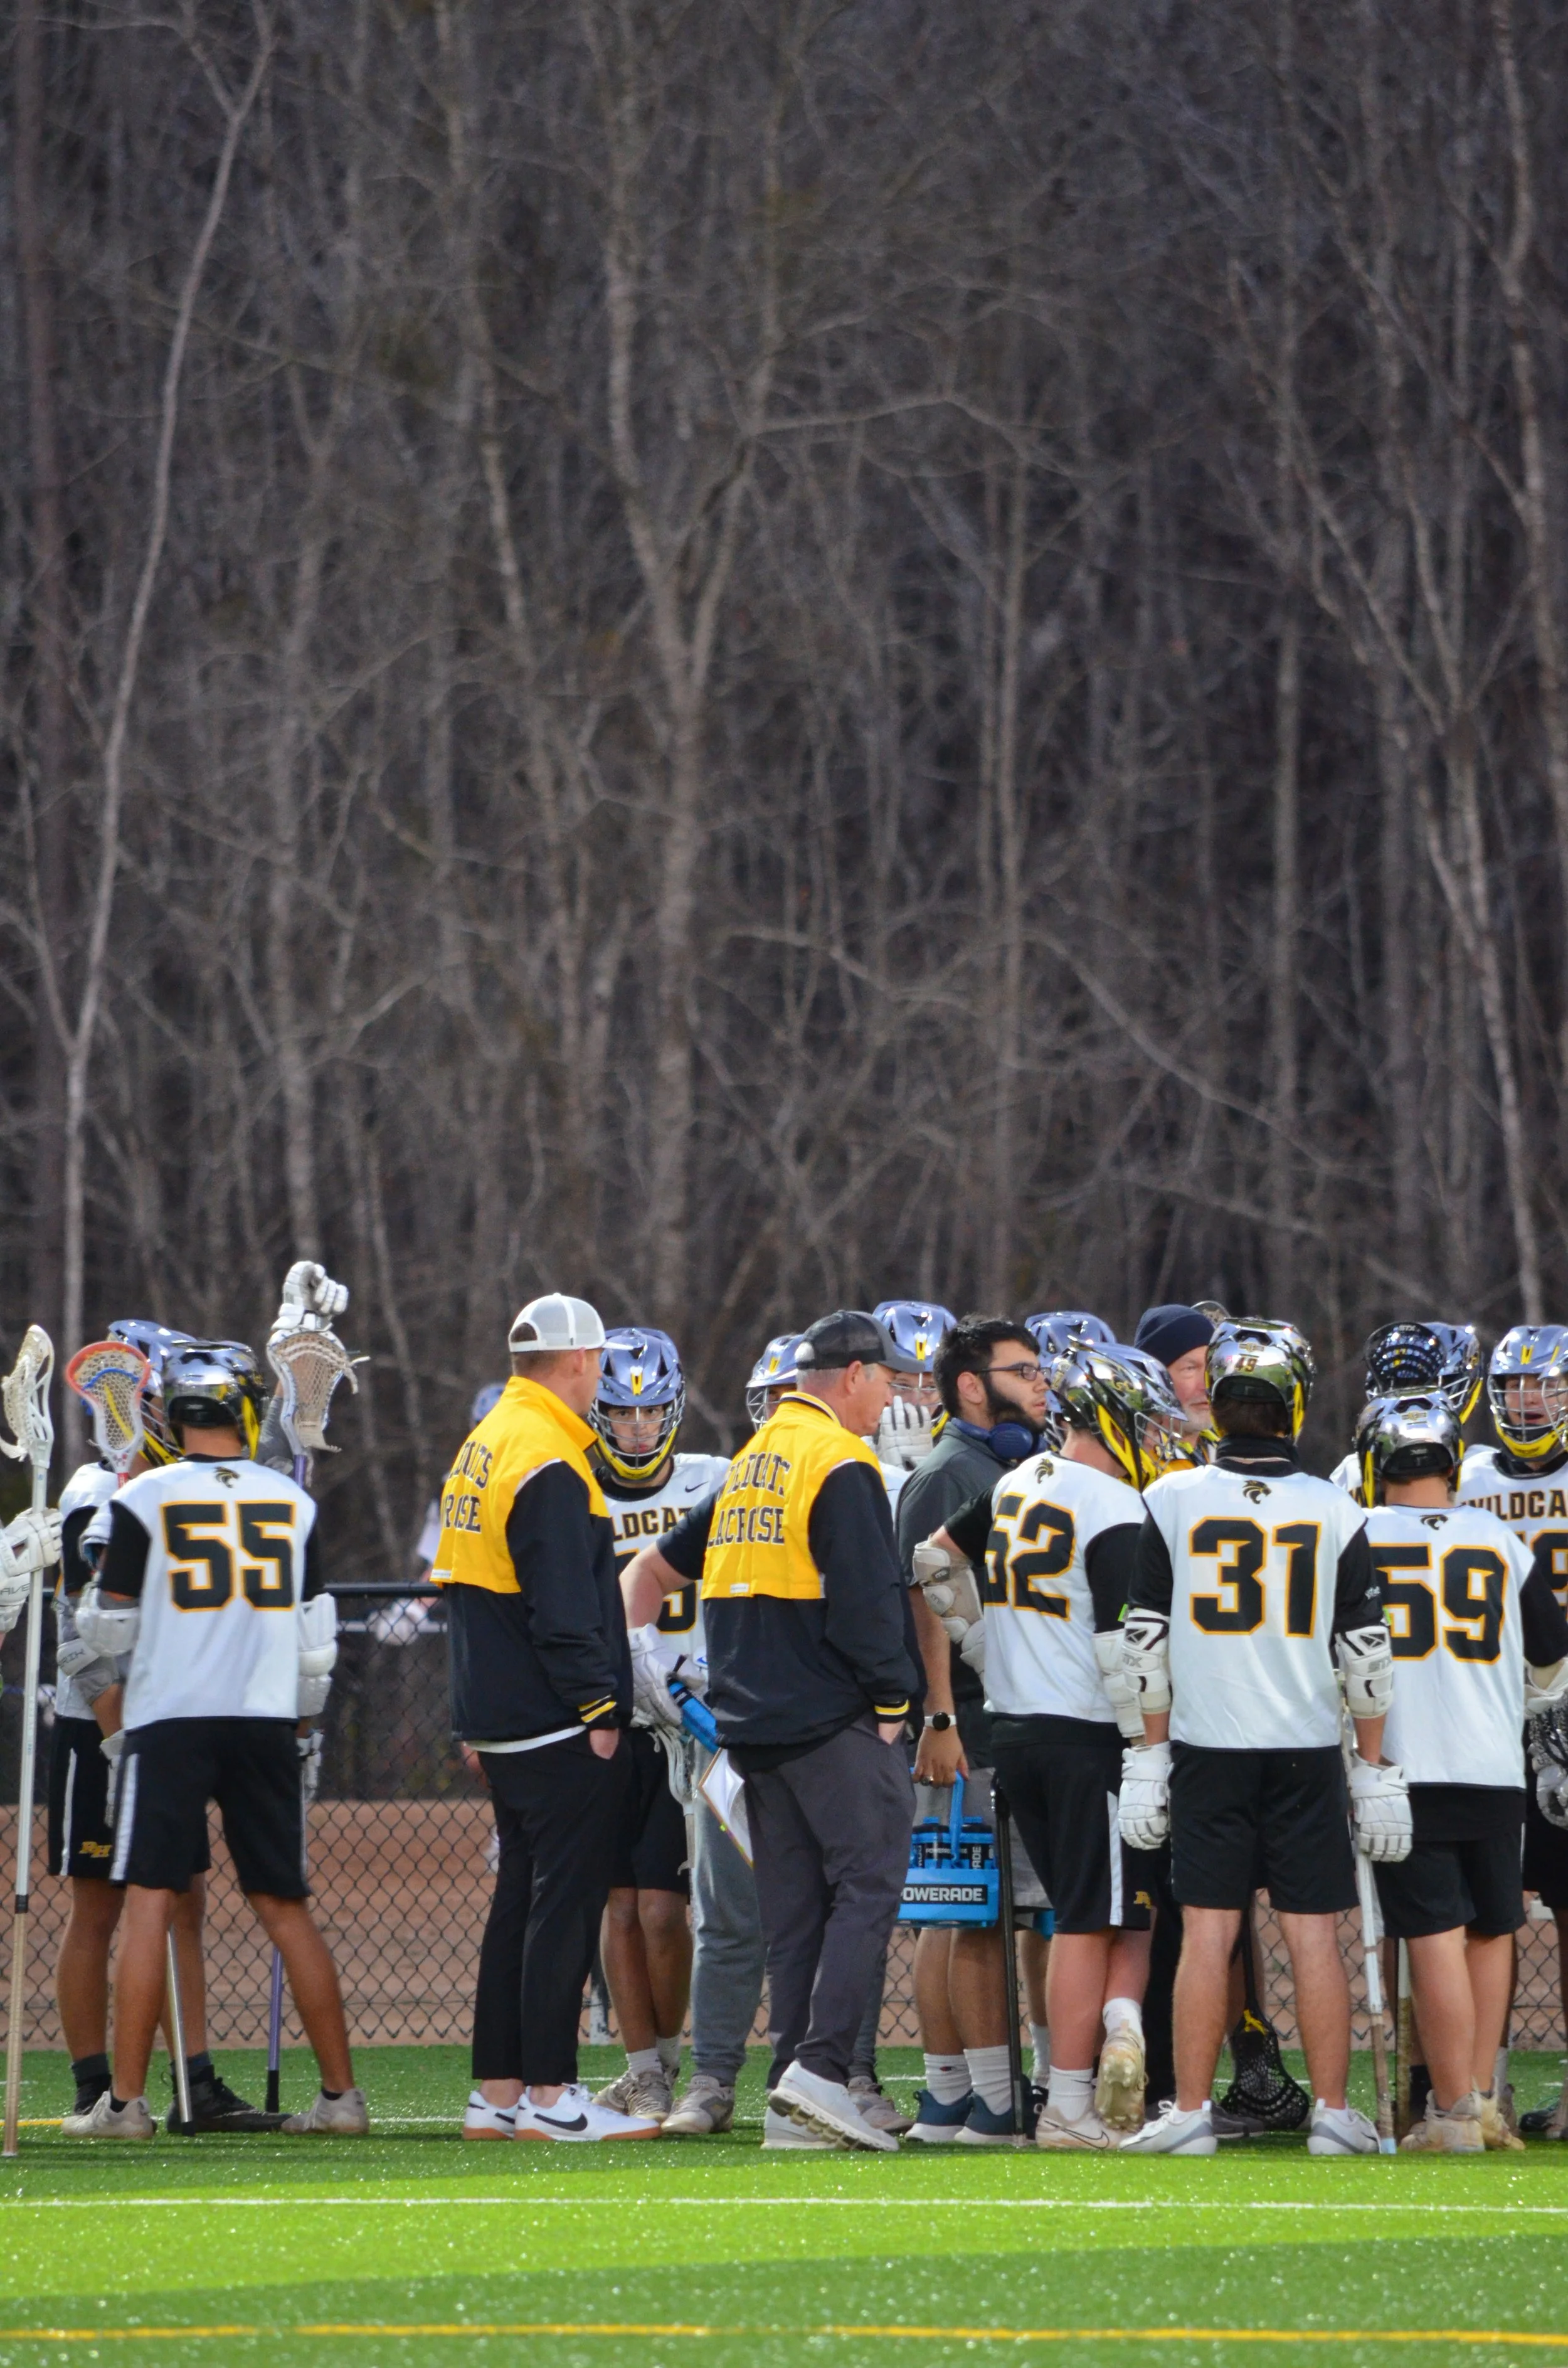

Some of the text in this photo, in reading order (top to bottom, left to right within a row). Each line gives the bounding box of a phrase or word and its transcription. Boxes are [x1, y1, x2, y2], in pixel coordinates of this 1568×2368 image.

[159, 1499, 297, 1613] 55
[1189, 1516, 1322, 1639] 31
[1369, 1542, 1510, 1666] 59
[901, 1886, 983, 1903] OWERADE
